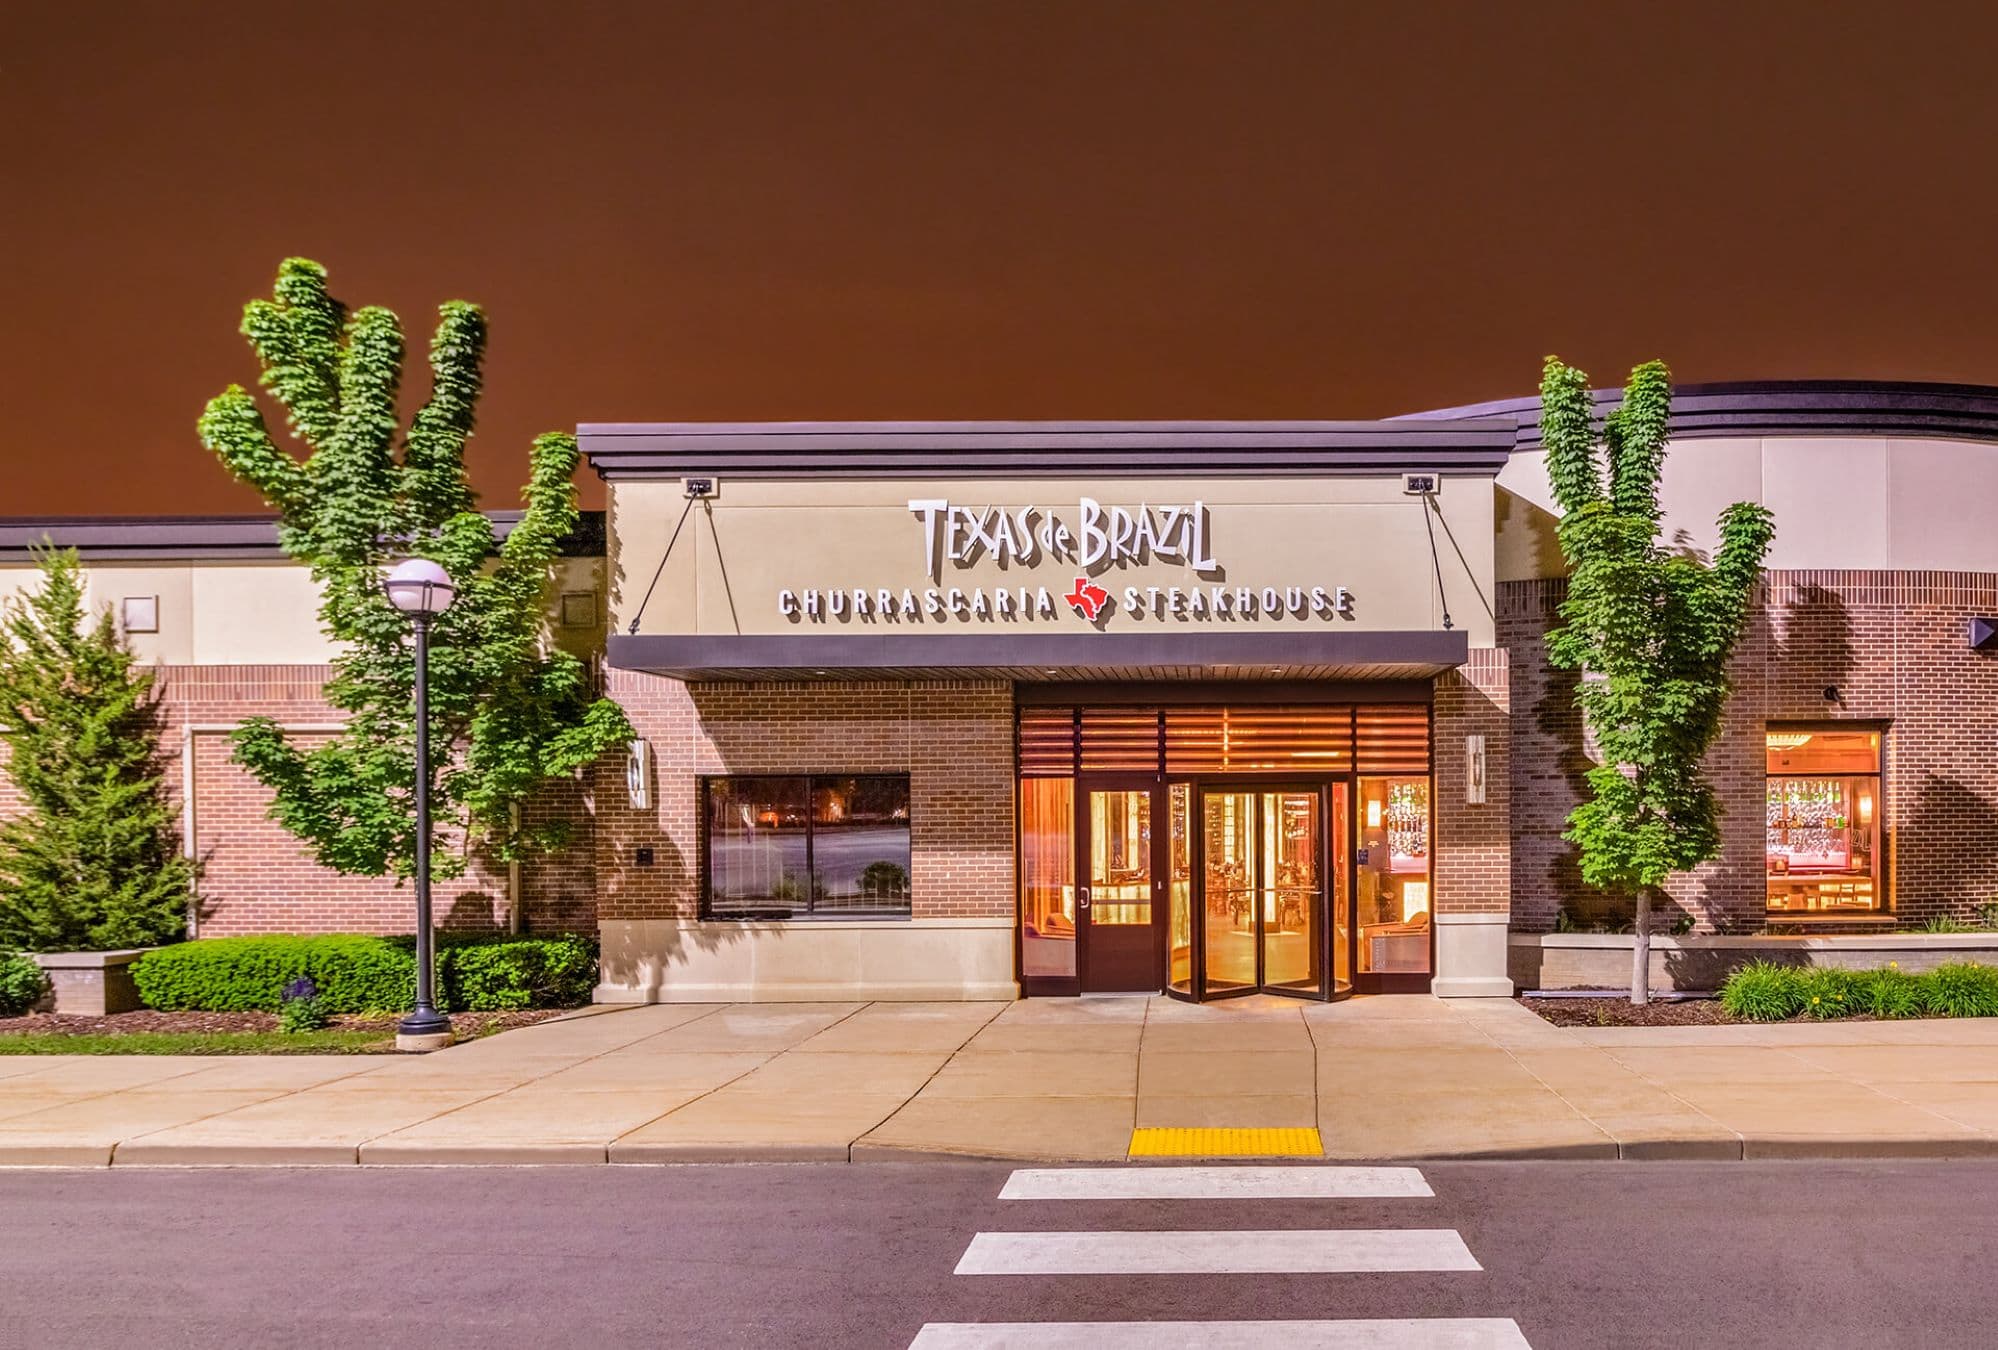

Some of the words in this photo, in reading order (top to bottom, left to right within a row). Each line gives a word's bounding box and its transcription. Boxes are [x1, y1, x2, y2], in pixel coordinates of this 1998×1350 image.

[908, 499, 1034, 576] TEXAS
[1041, 510, 1070, 554] de
[778, 587, 1051, 615] CHURRASCARIA
[1123, 586, 1347, 612] STEAKHOUSE
